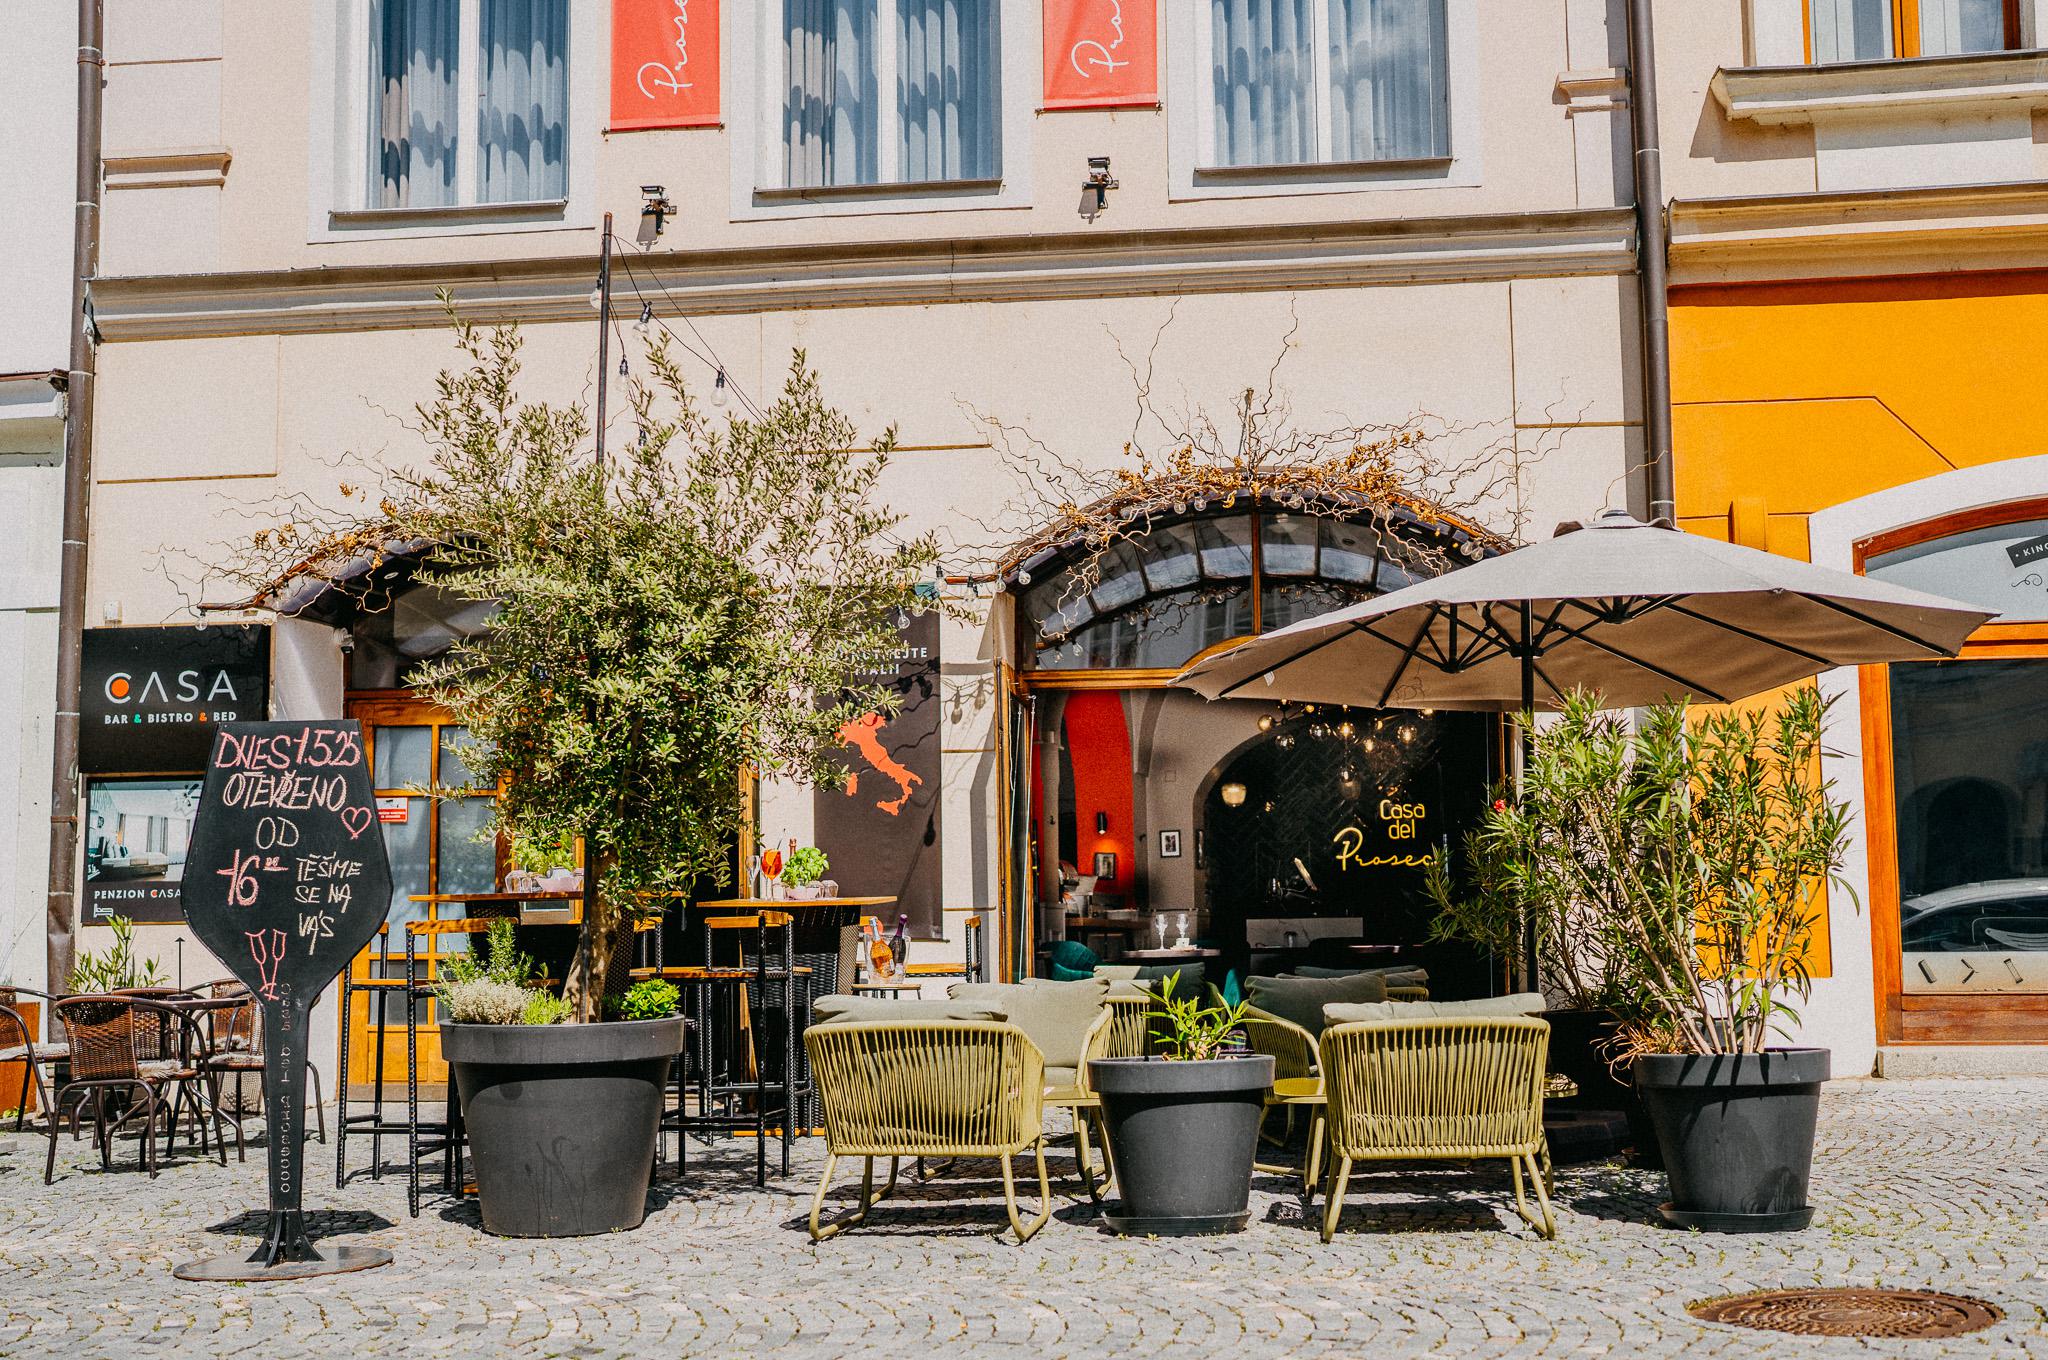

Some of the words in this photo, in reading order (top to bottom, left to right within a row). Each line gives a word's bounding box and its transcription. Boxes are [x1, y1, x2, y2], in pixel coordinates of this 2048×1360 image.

[1071, 0, 1130, 78] Pro
[104, 669, 238, 704] CASA
[104, 714, 128, 725] BAR
[133, 713, 142, 724] &
[147, 712, 193, 723] BISTRO
[199, 711, 208, 722] &
[213, 711, 237, 722] BED
[215, 732, 291, 770] DNES
[1380, 799, 1425, 820] Casa
[256, 816, 299, 850] OD
[1388, 818, 1416, 840] del
[94, 889, 145, 899] PENZION
[150, 889, 181, 898] CASA
[294, 885, 321, 903] SE
[327, 883, 353, 913] NA
